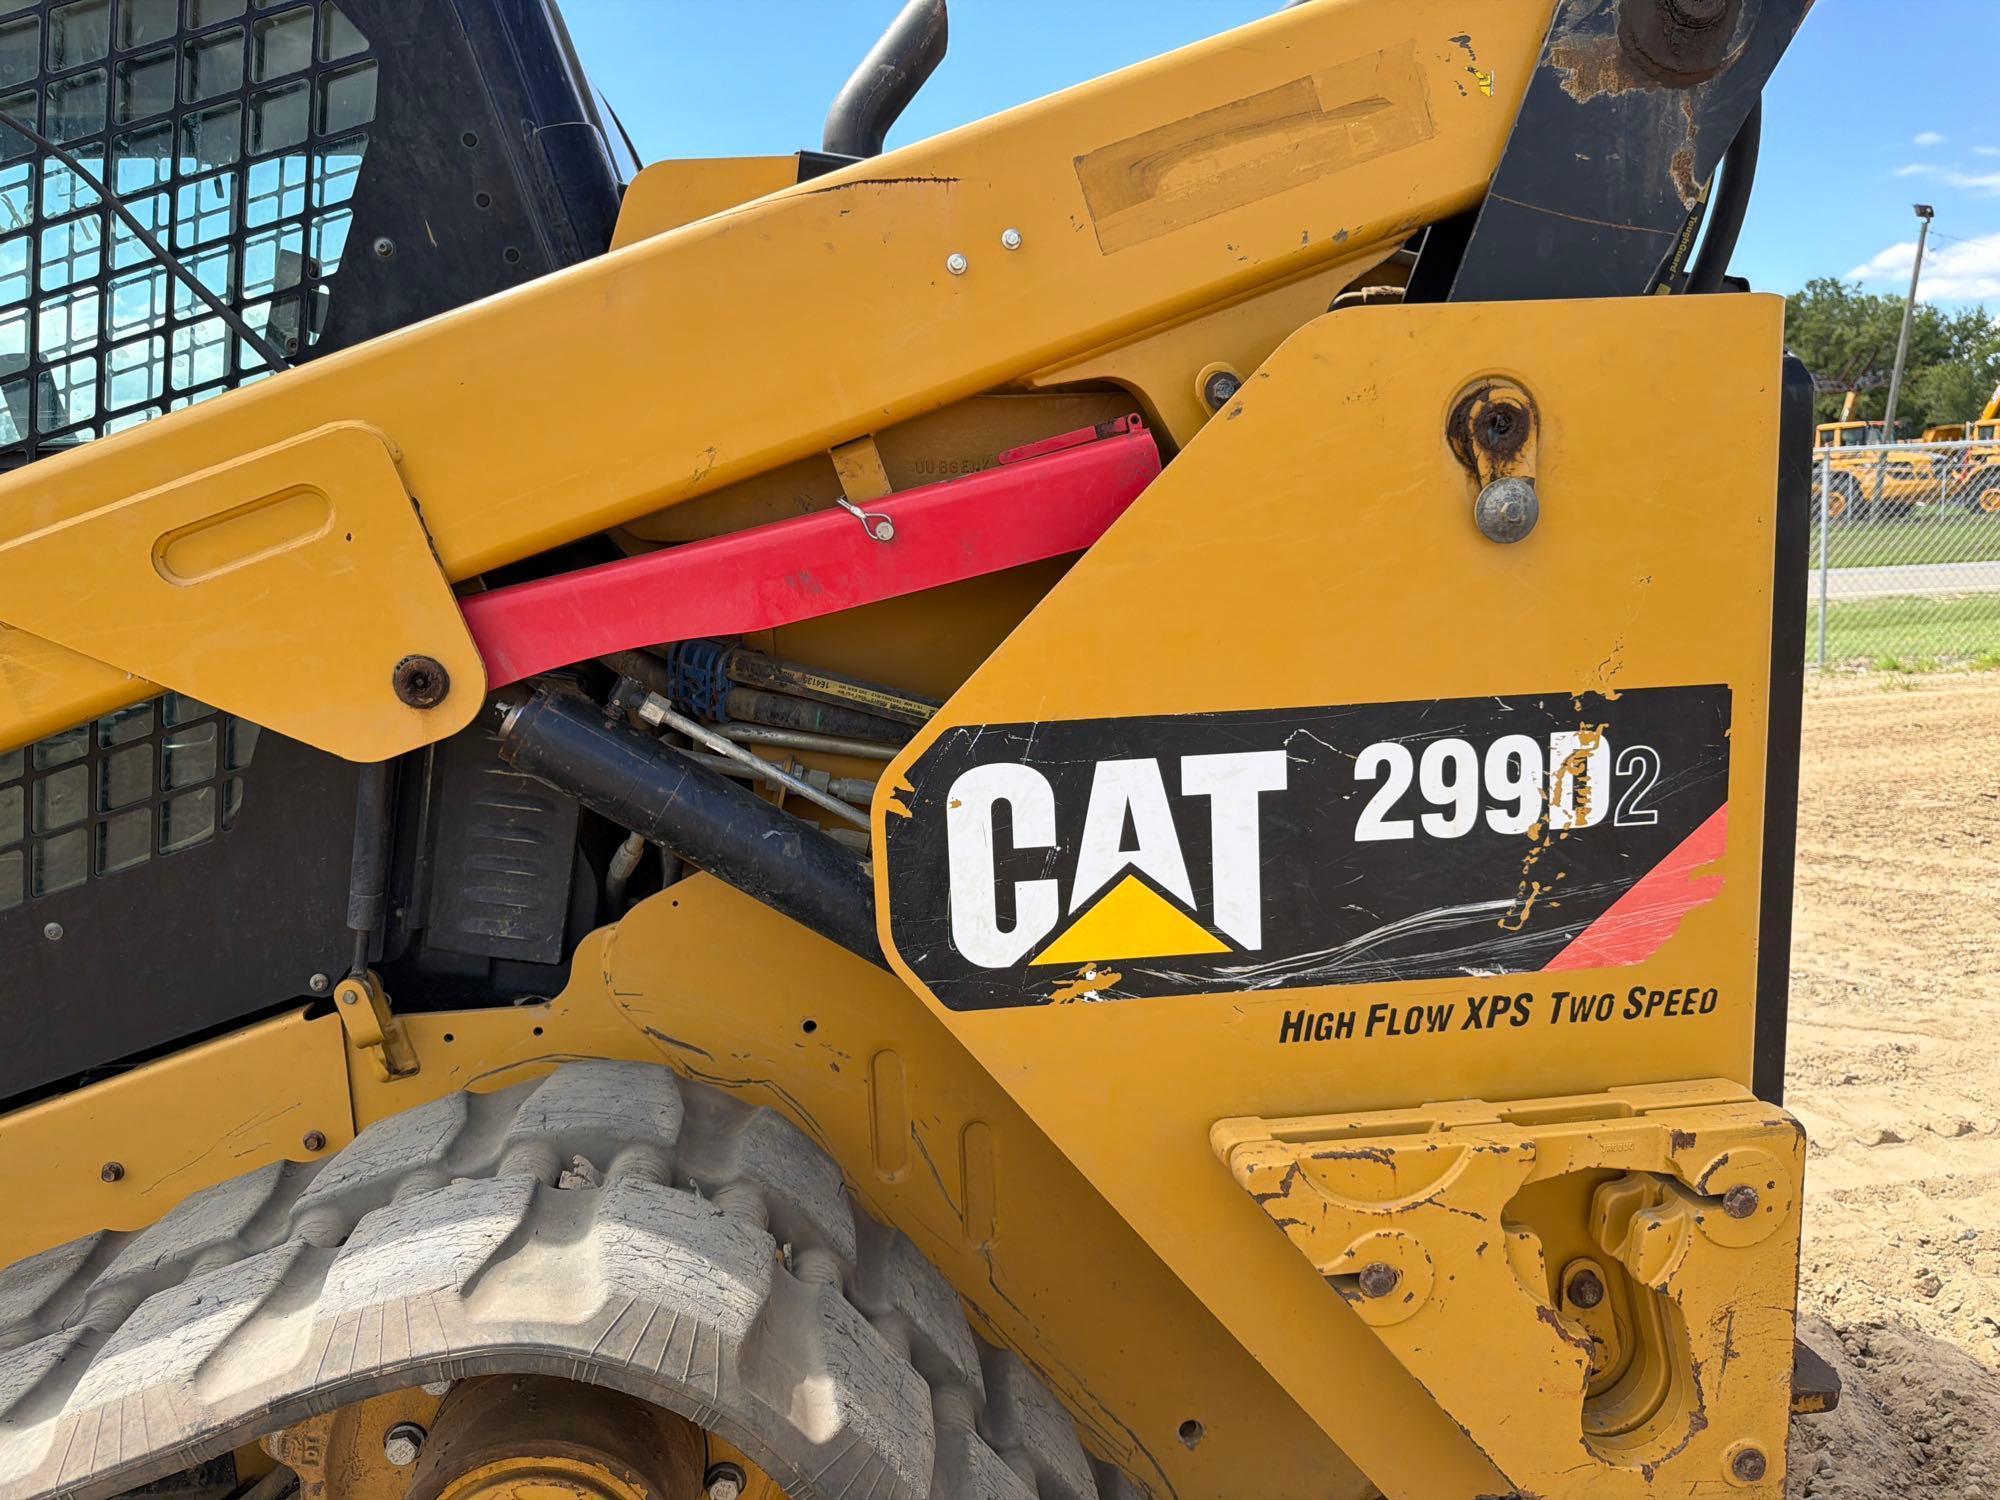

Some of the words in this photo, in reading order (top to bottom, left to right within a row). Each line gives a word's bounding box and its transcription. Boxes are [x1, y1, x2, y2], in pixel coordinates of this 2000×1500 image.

[946, 750, 1288, 969] CAT
[1279, 1009, 1356, 1044] HIGH
[1364, 1002, 1455, 1038] FLOW
[1460, 993, 1534, 1031] XPS
[1550, 991, 1615, 1025] TWO
[1622, 985, 1719, 1020] SPEED
